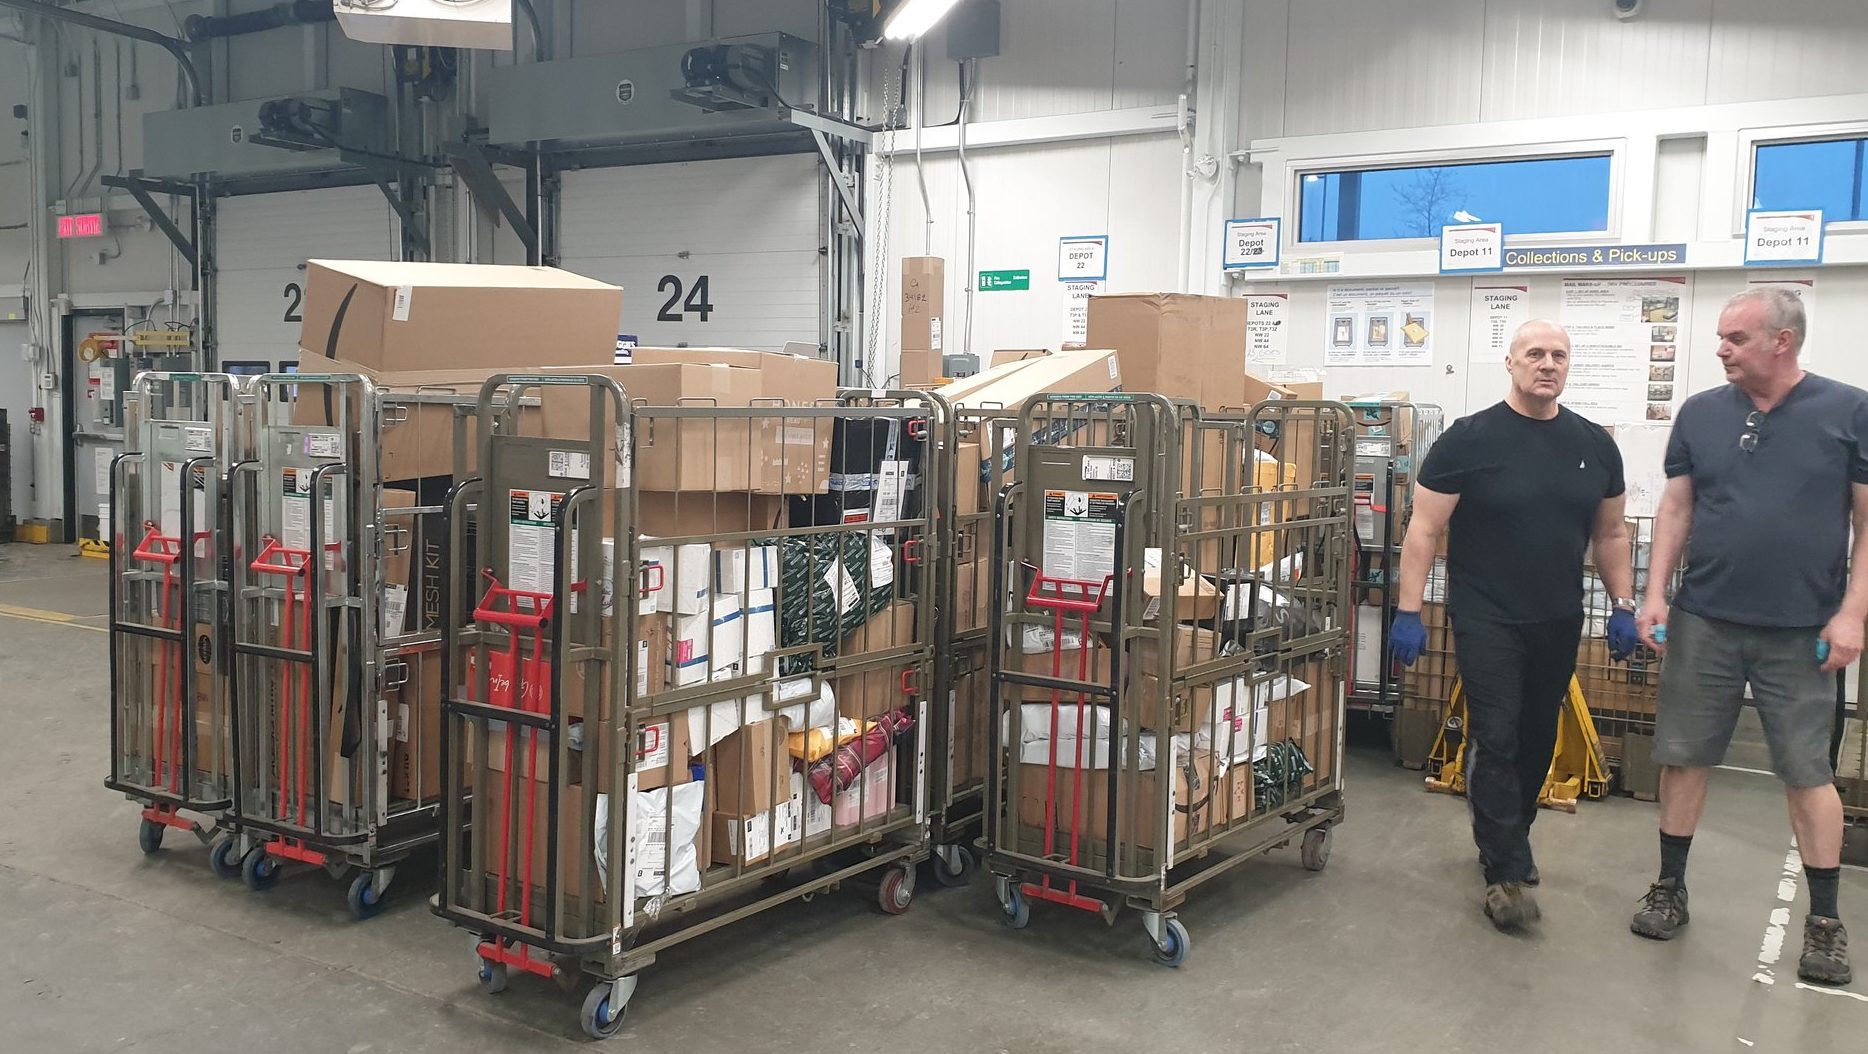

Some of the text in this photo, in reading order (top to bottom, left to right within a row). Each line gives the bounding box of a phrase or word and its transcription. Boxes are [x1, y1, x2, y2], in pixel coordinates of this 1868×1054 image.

[1238, 239, 1264, 248] Depot
[1757, 236, 1809, 248] Depot 11
[1069, 252, 1093, 260] DEPOT
[1450, 247, 1492, 258] Depot 11
[1505, 249, 1678, 265] Collections & Pick-ups
[283, 282, 304, 323] 2
[656, 274, 714, 322] 24
[425, 538, 440, 630] MESH KIT
